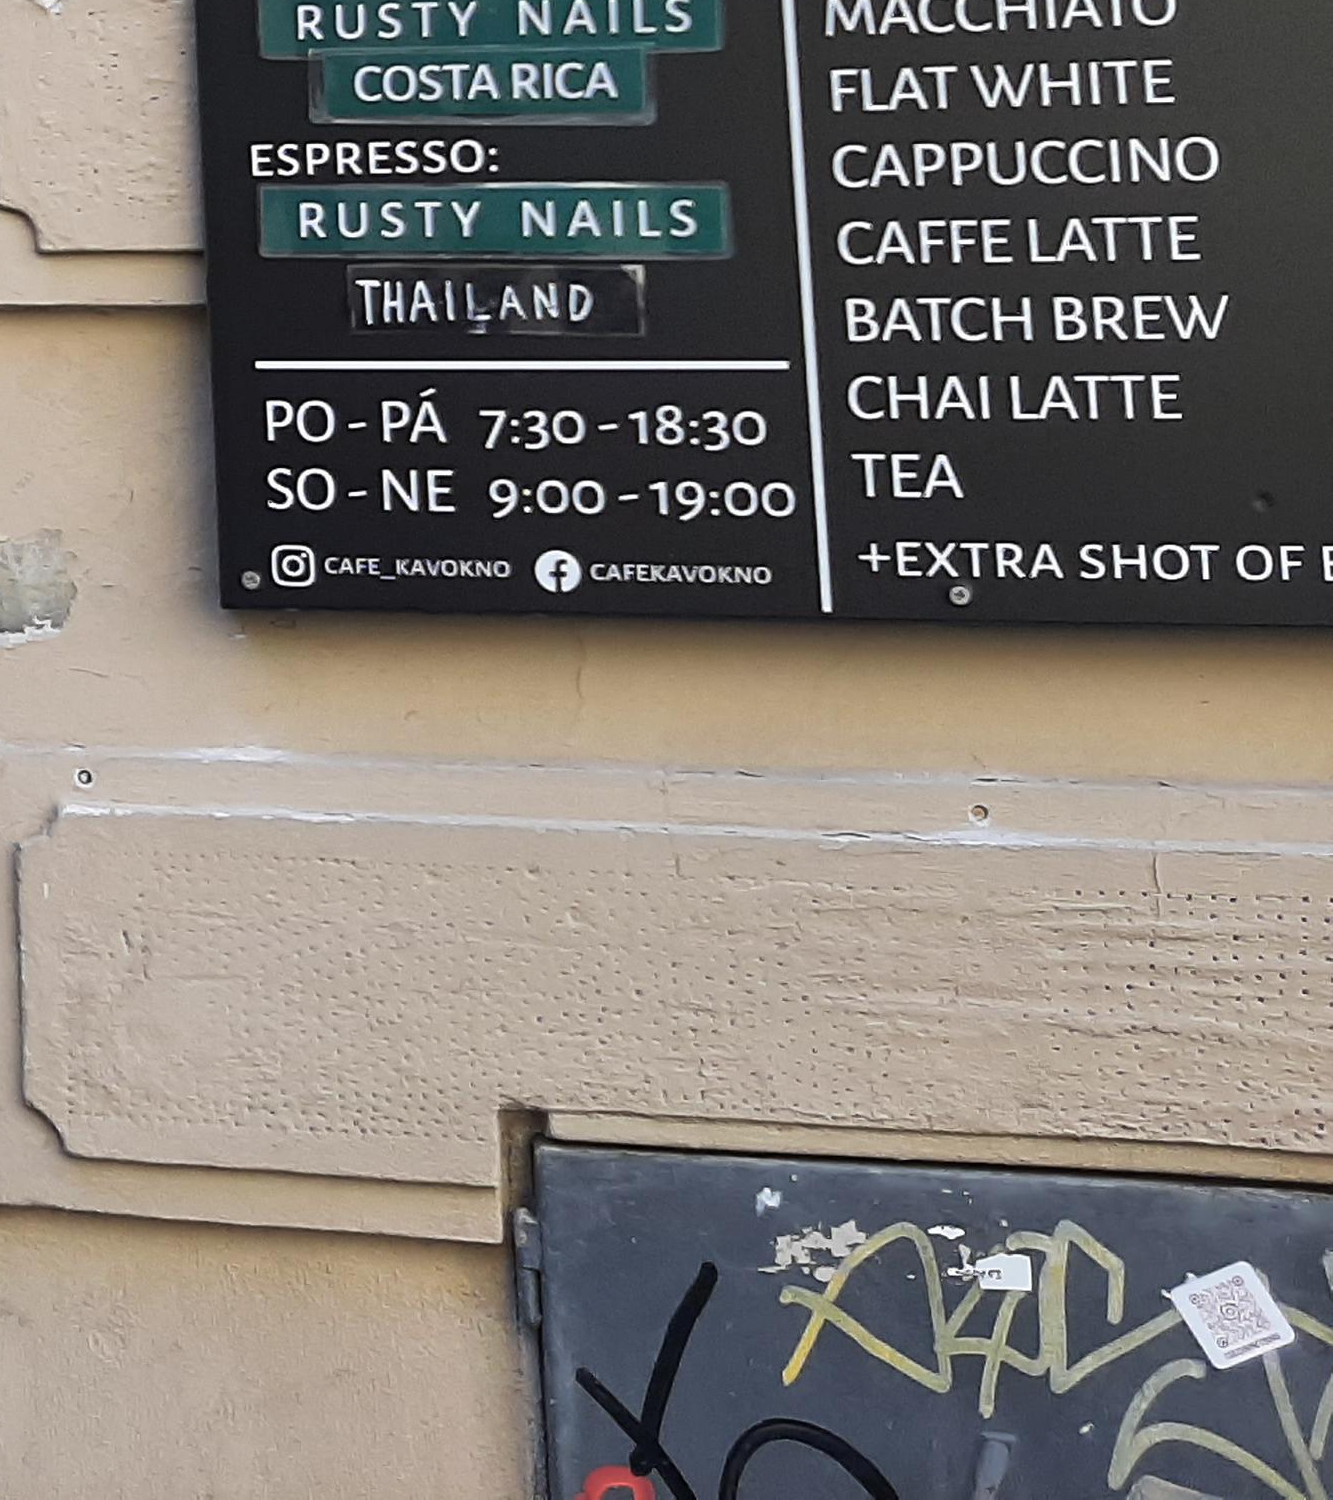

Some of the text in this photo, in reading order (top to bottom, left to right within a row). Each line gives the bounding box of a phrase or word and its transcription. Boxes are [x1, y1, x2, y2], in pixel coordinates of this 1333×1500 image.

[297, 0, 477, 40] RUSTY
[354, 61, 619, 102] COSTA RICA
[830, 59, 1176, 112] FLAT WHITE
[250, 139, 499, 177] ESPRESSO:
[832, 136, 1219, 188] CAPPUCCINO
[299, 199, 697, 238] RUSTY NAILS
[837, 215, 1201, 265] CAFFE LATTE
[354, 279, 595, 325] THAILAND
[845, 294, 1229, 342] BATCH BREW
[265, 400, 335, 443] PO
[381, 387, 447, 443] PÁ
[479, 410, 586, 450] 7:30
[628, 404, 767, 451] 18:30
[847, 374, 1183, 420] CHAI LATTE
[267, 467, 336, 511] SO
[382, 469, 456, 513] NE
[489, 478, 606, 519] 9:00
[648, 480, 796, 521] 19:00
[850, 453, 964, 499] TEA
[324, 556, 511, 580] CAFE_KAVOKNO
[589, 563, 772, 585] CAFEKAVOKNO
[858, 541, 1064, 579] +EXTRA
[1079, 543, 1220, 581] SHOT
[1235, 544, 1305, 581] OF
